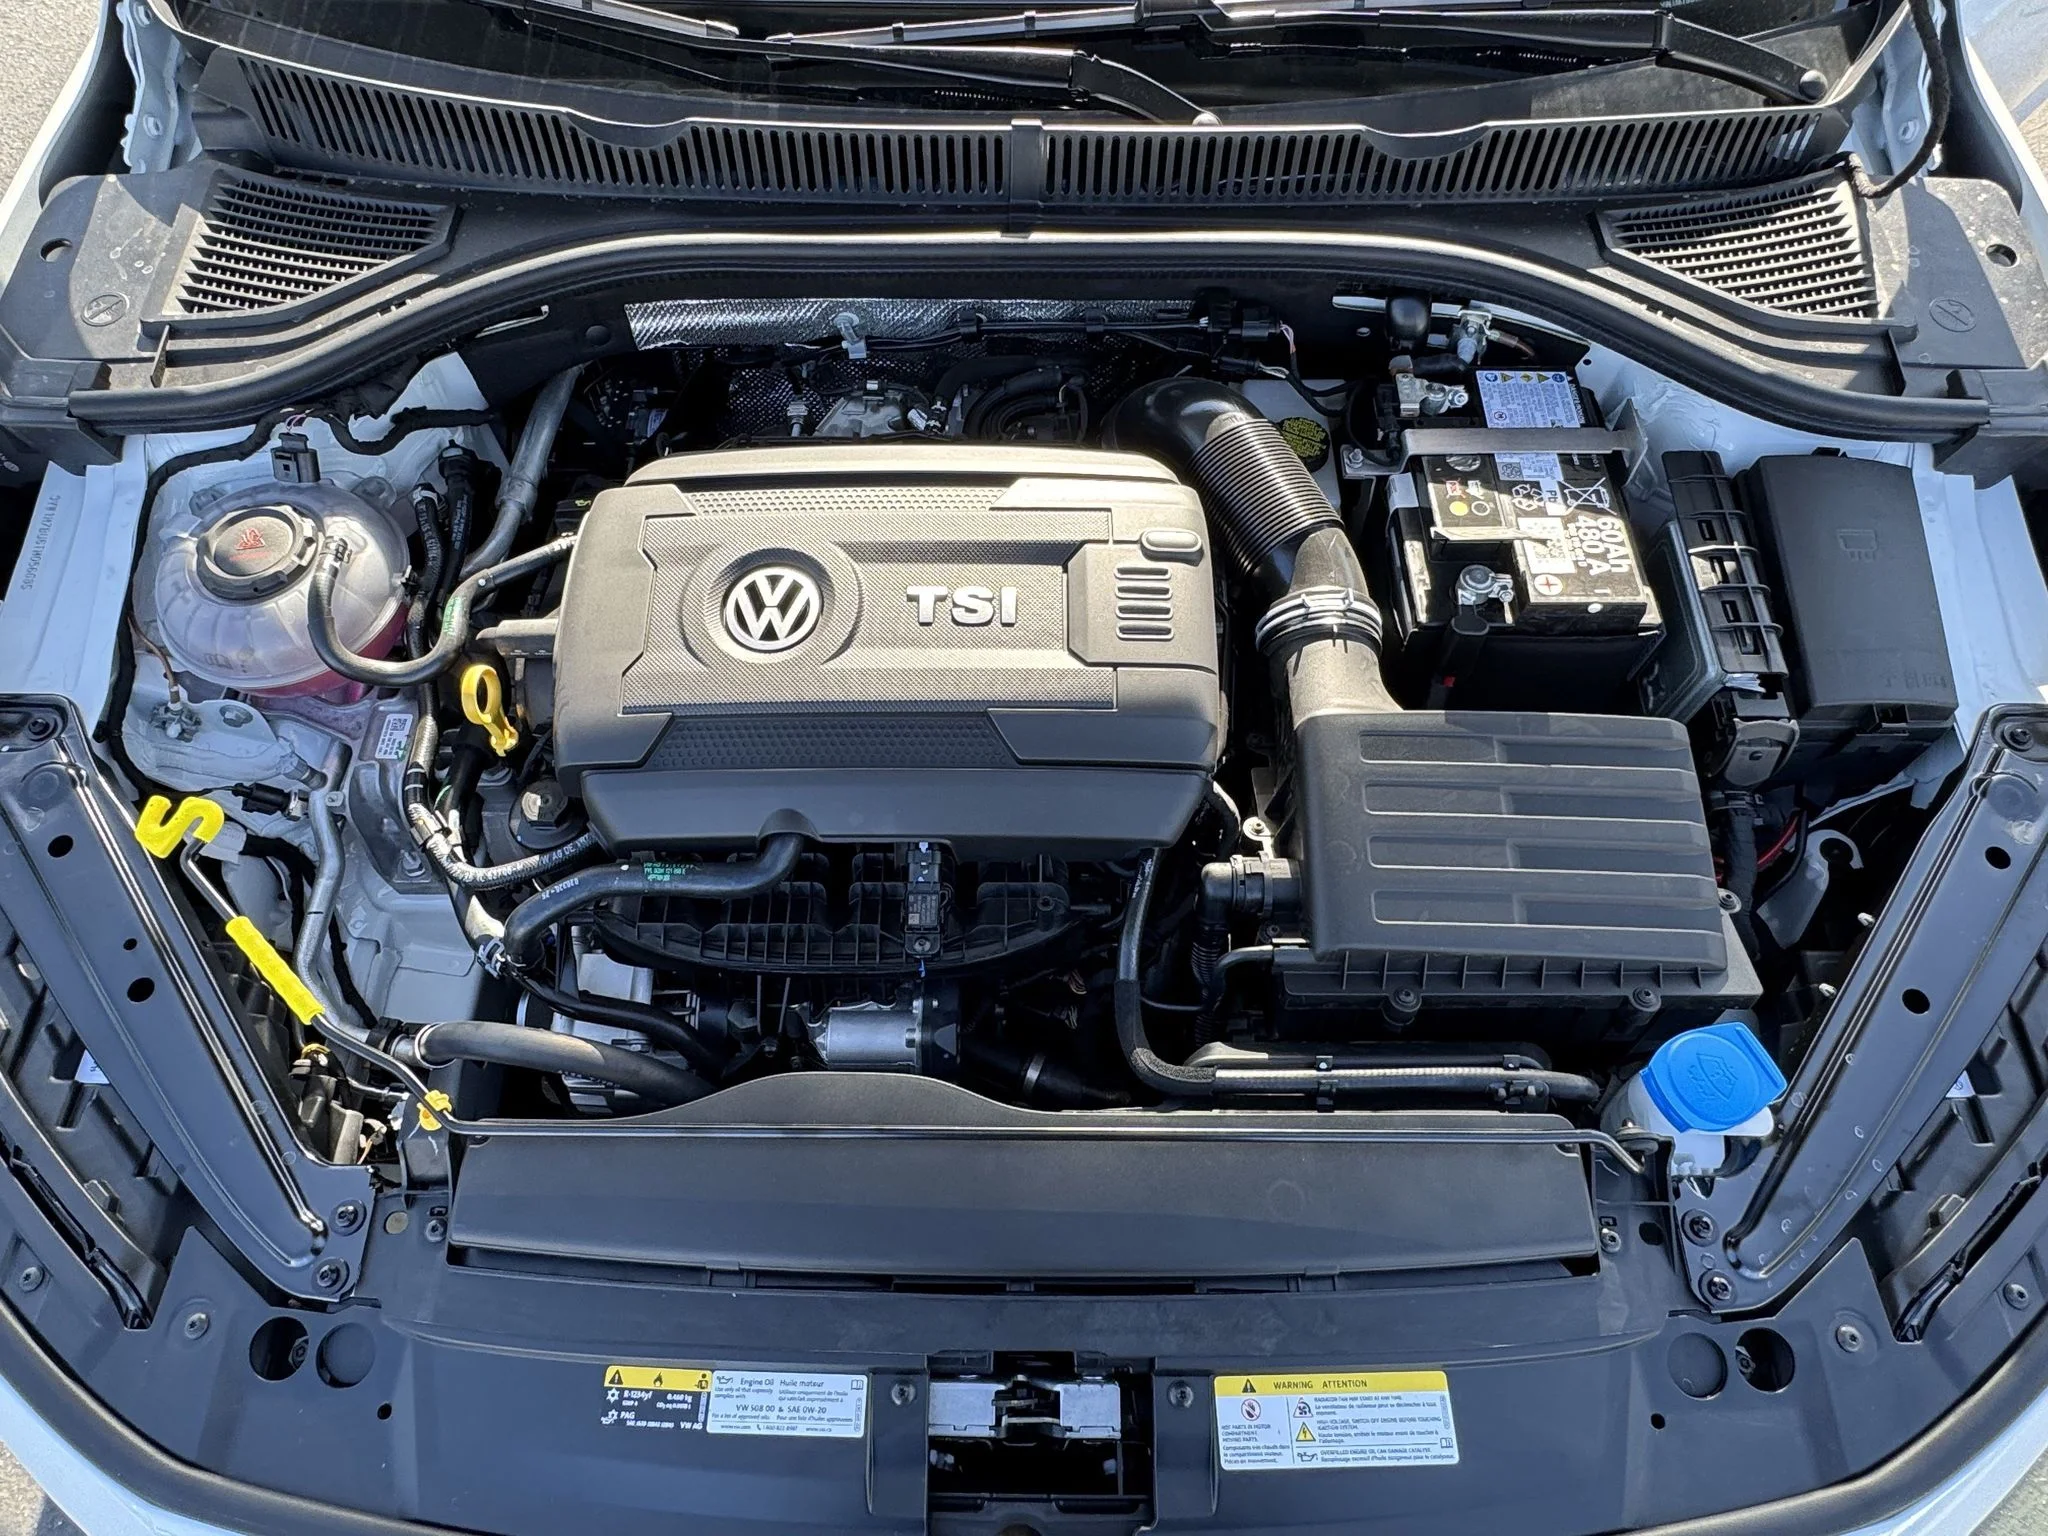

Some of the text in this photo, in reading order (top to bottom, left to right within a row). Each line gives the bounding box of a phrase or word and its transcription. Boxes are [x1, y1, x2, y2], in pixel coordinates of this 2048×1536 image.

[1545, 490, 1559, 505] Pb
[1575, 515, 1604, 554] 480
[1596, 517, 1632, 574] 60Ah
[1586, 558, 1612, 576] A
[906, 585, 1018, 628] TSI
[740, 1378, 774, 1387] Engine Oil
[779, 1379, 797, 1387] Huile
[1273, 1379, 1368, 1390] WARNING ATTENTION
[623, 1390, 653, 1401] R-1234yf
[750, 1404, 764, 1412] 508
[787, 1405, 800, 1413] SAE
[803, 1406, 827, 1414] 0W-20
[620, 1411, 636, 1420] PAG
[680, 1421, 692, 1429] VW
[692, 1422, 703, 1430] AG
